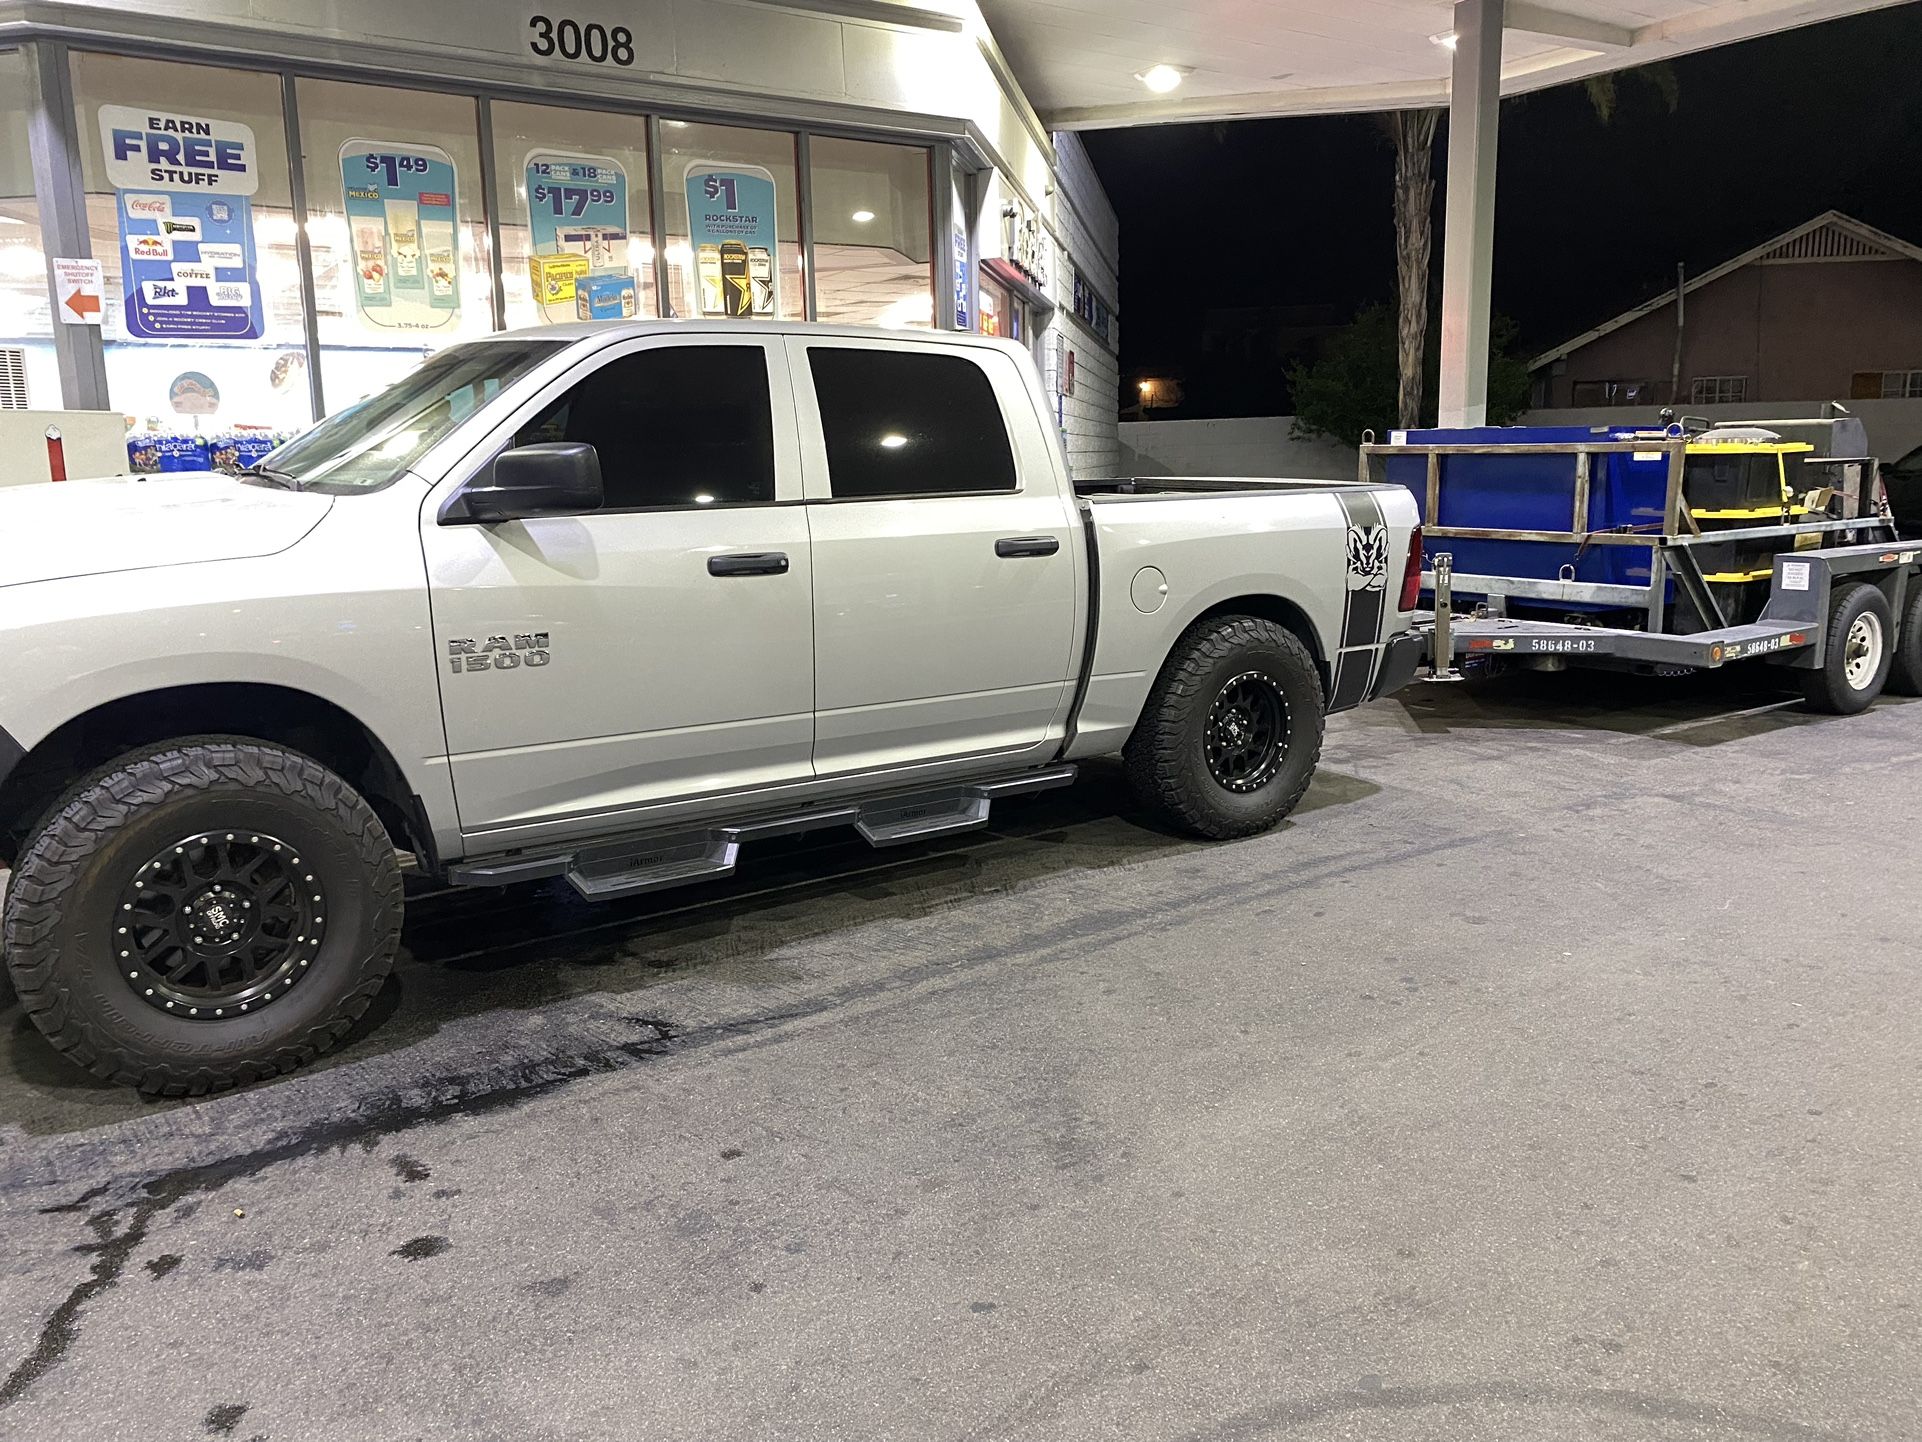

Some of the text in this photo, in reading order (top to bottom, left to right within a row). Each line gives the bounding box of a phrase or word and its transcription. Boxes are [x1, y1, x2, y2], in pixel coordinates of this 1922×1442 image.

[530, 16, 634, 66] 3008
[148, 116, 210, 136] EARN
[112, 128, 246, 172] FREE
[150, 168, 219, 186] STUFF
[534, 162, 550, 175] 12
[580, 166, 598, 179] 18
[348, 191, 378, 199] MEXICO
[704, 174, 738, 212] $1
[705, 214, 758, 223] ROCKSTAR
[134, 248, 168, 256] Red Bull
[177, 270, 211, 279] COFFEE
[448, 632, 550, 655] RAM
[1532, 639, 1595, 651] 58648-03
[1747, 638, 1779, 654] 58648-03
[449, 650, 550, 674] 1500
[211, 906, 229, 927] SMC
